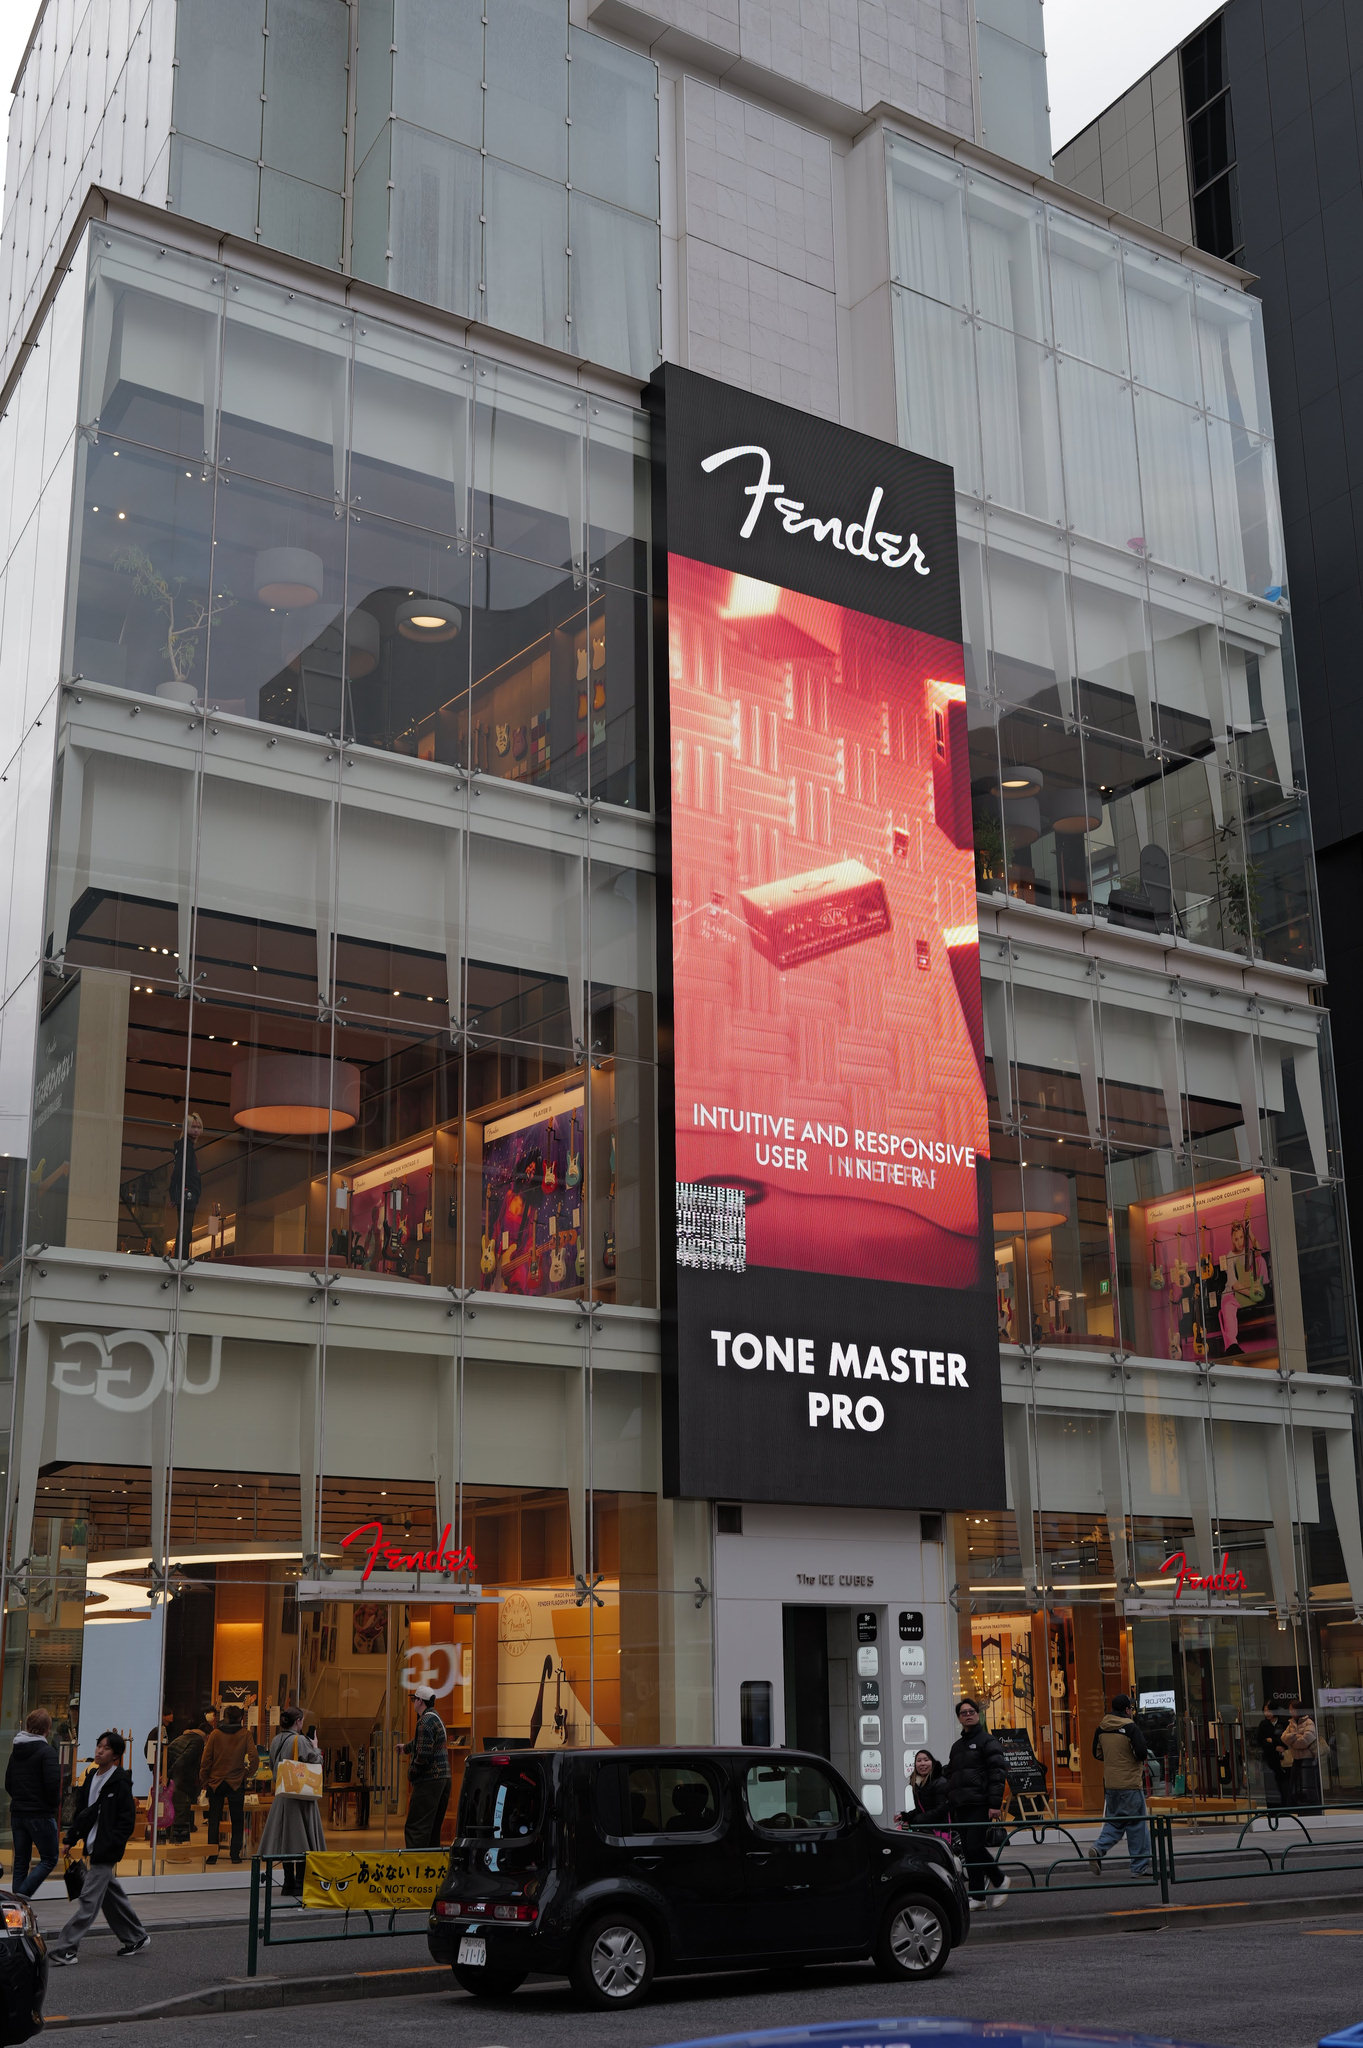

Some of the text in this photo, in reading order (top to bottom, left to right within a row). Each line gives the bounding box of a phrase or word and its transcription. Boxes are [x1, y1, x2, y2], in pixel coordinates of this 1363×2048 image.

[701, 445, 930, 575] Fender
[533, 1109, 548, 1118] PLAYER
[693, 1103, 975, 1168] INTUITIVE AND RESPONSIVE
[756, 1142, 808, 1171] USER
[1172, 1204, 1185, 1212] MADE
[1206, 1194, 1223, 1204] JUNIOR
[1224, 1186, 1250, 1199] COLLECTION
[711, 1330, 969, 1388] TONE MASTER
[808, 1391, 885, 1432] PRO
[340, 1522, 478, 1580] Fender
[796, 1574, 874, 1587] The ICE CUBES
[1160, 1552, 1247, 1599] Fender
[903, 1693, 924, 1701] artifata
[369, 1884, 382, 1894] Do
[385, 1884, 405, 1894] NOT
[408, 1885, 433, 1894] cross
